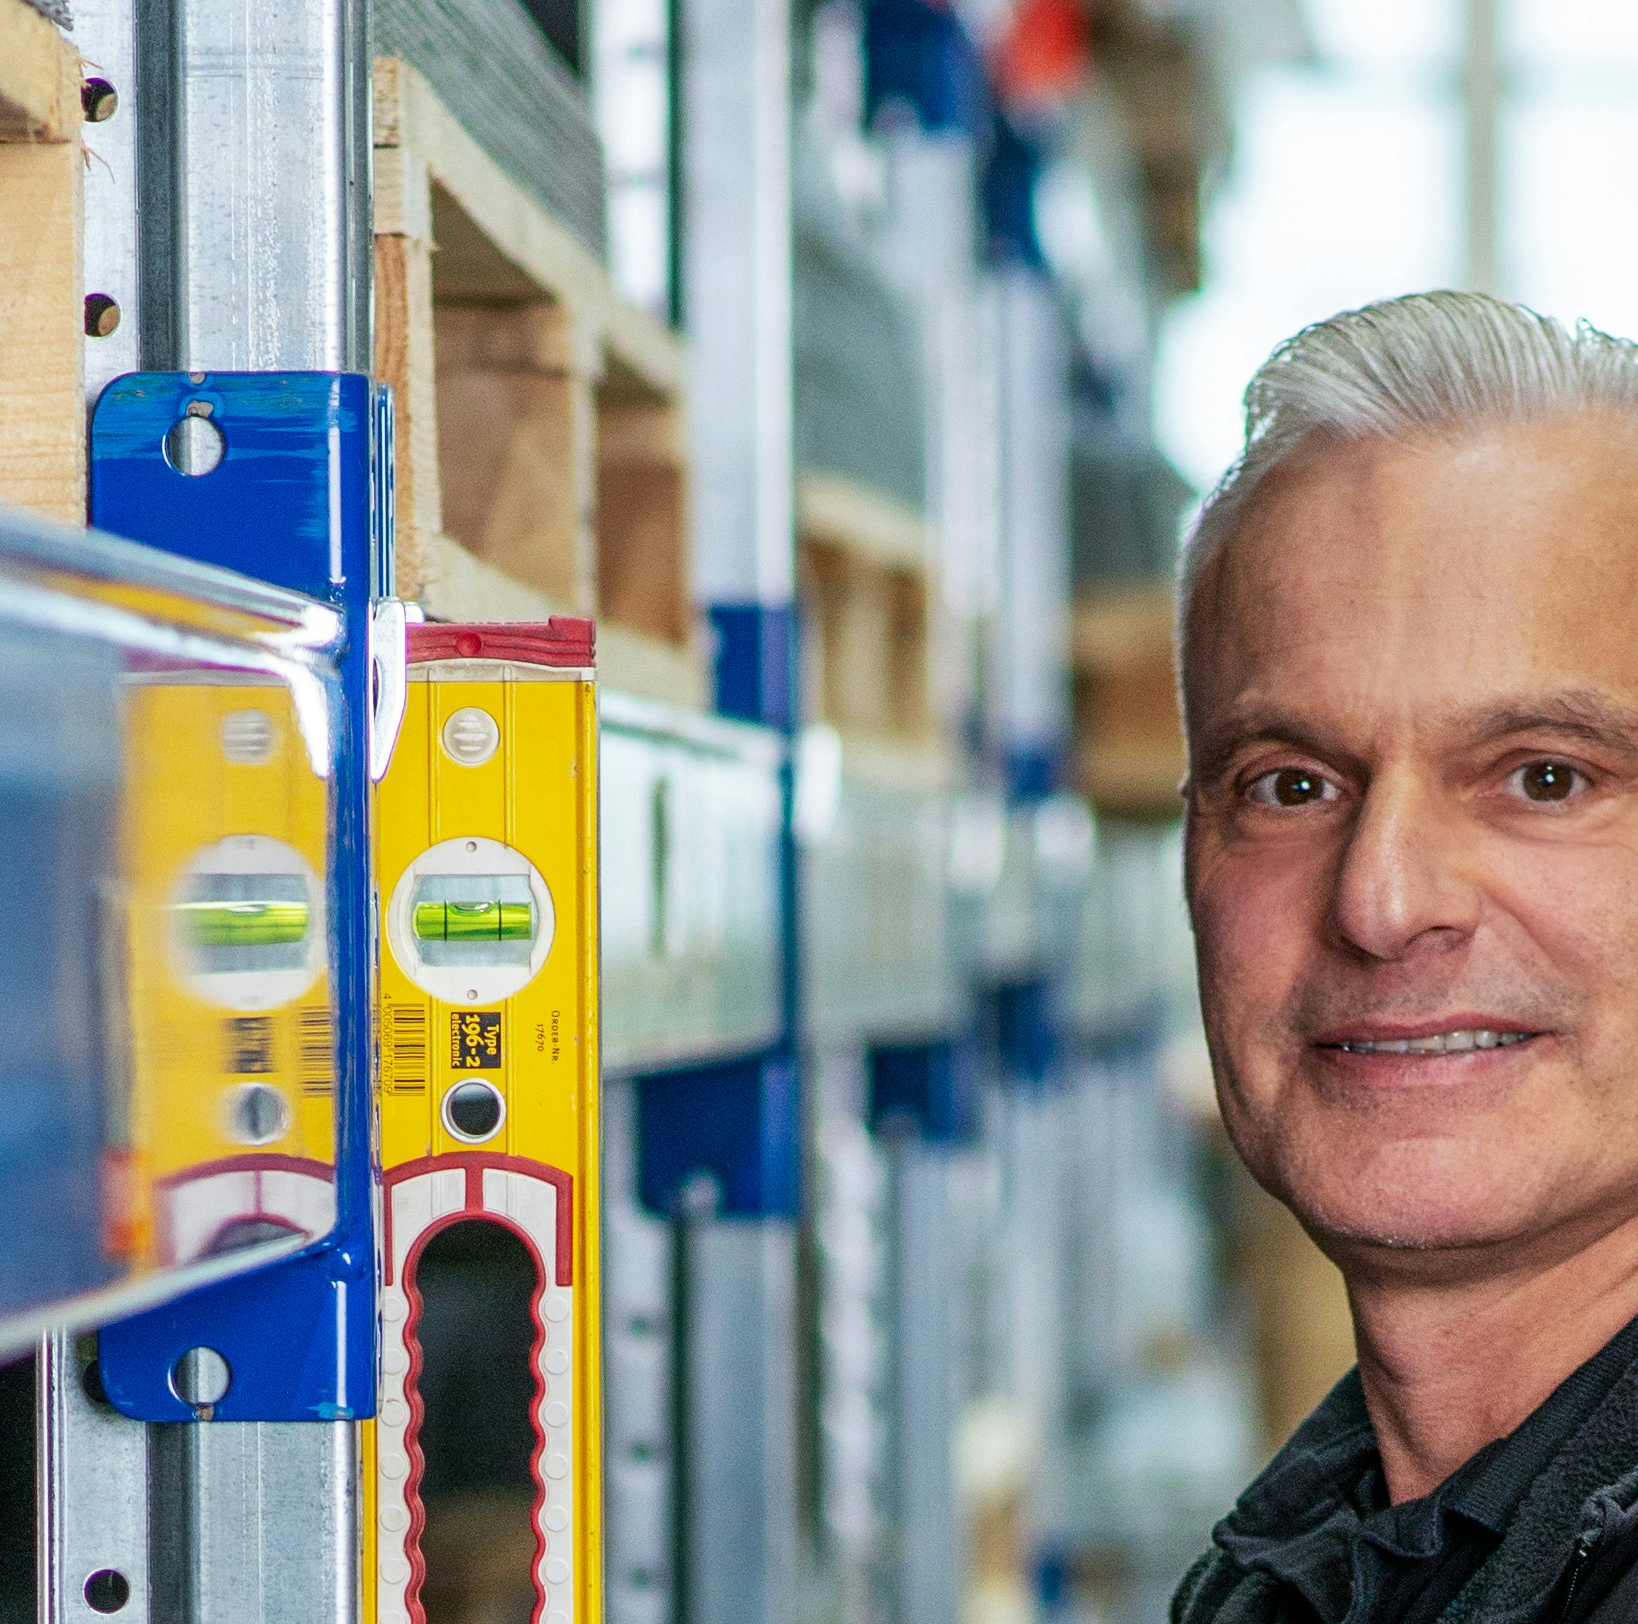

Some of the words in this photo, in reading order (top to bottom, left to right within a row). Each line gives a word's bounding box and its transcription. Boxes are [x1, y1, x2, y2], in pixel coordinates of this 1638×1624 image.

[383, 1006, 393, 1048] 005069
[451, 1013, 463, 1067] electronic
[462, 1014, 484, 1068] 196-2
[484, 1024, 499, 1056] Type
[535, 1024, 544, 1052] 17670
[383, 1054, 393, 1094] 176709
